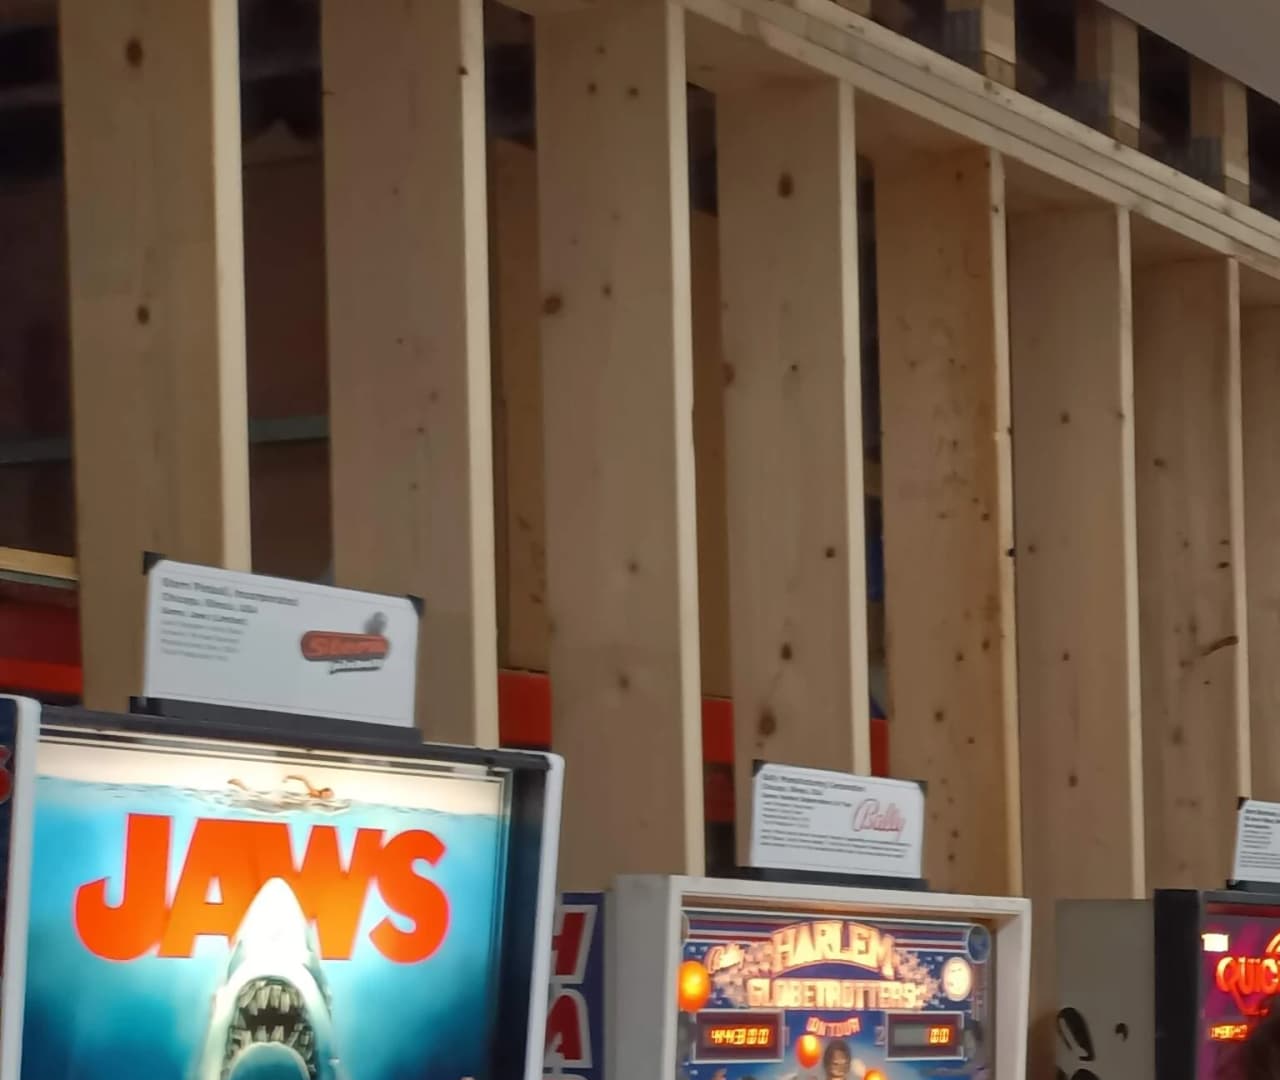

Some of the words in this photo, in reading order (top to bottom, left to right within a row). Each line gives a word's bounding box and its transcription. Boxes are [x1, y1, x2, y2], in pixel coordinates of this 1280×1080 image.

[853, 799, 904, 839] Bally
[73, 812, 451, 964] JAWS
[773, 920, 896, 979] HARLEM
[747, 978, 920, 1009] GLOBETROTTERS
